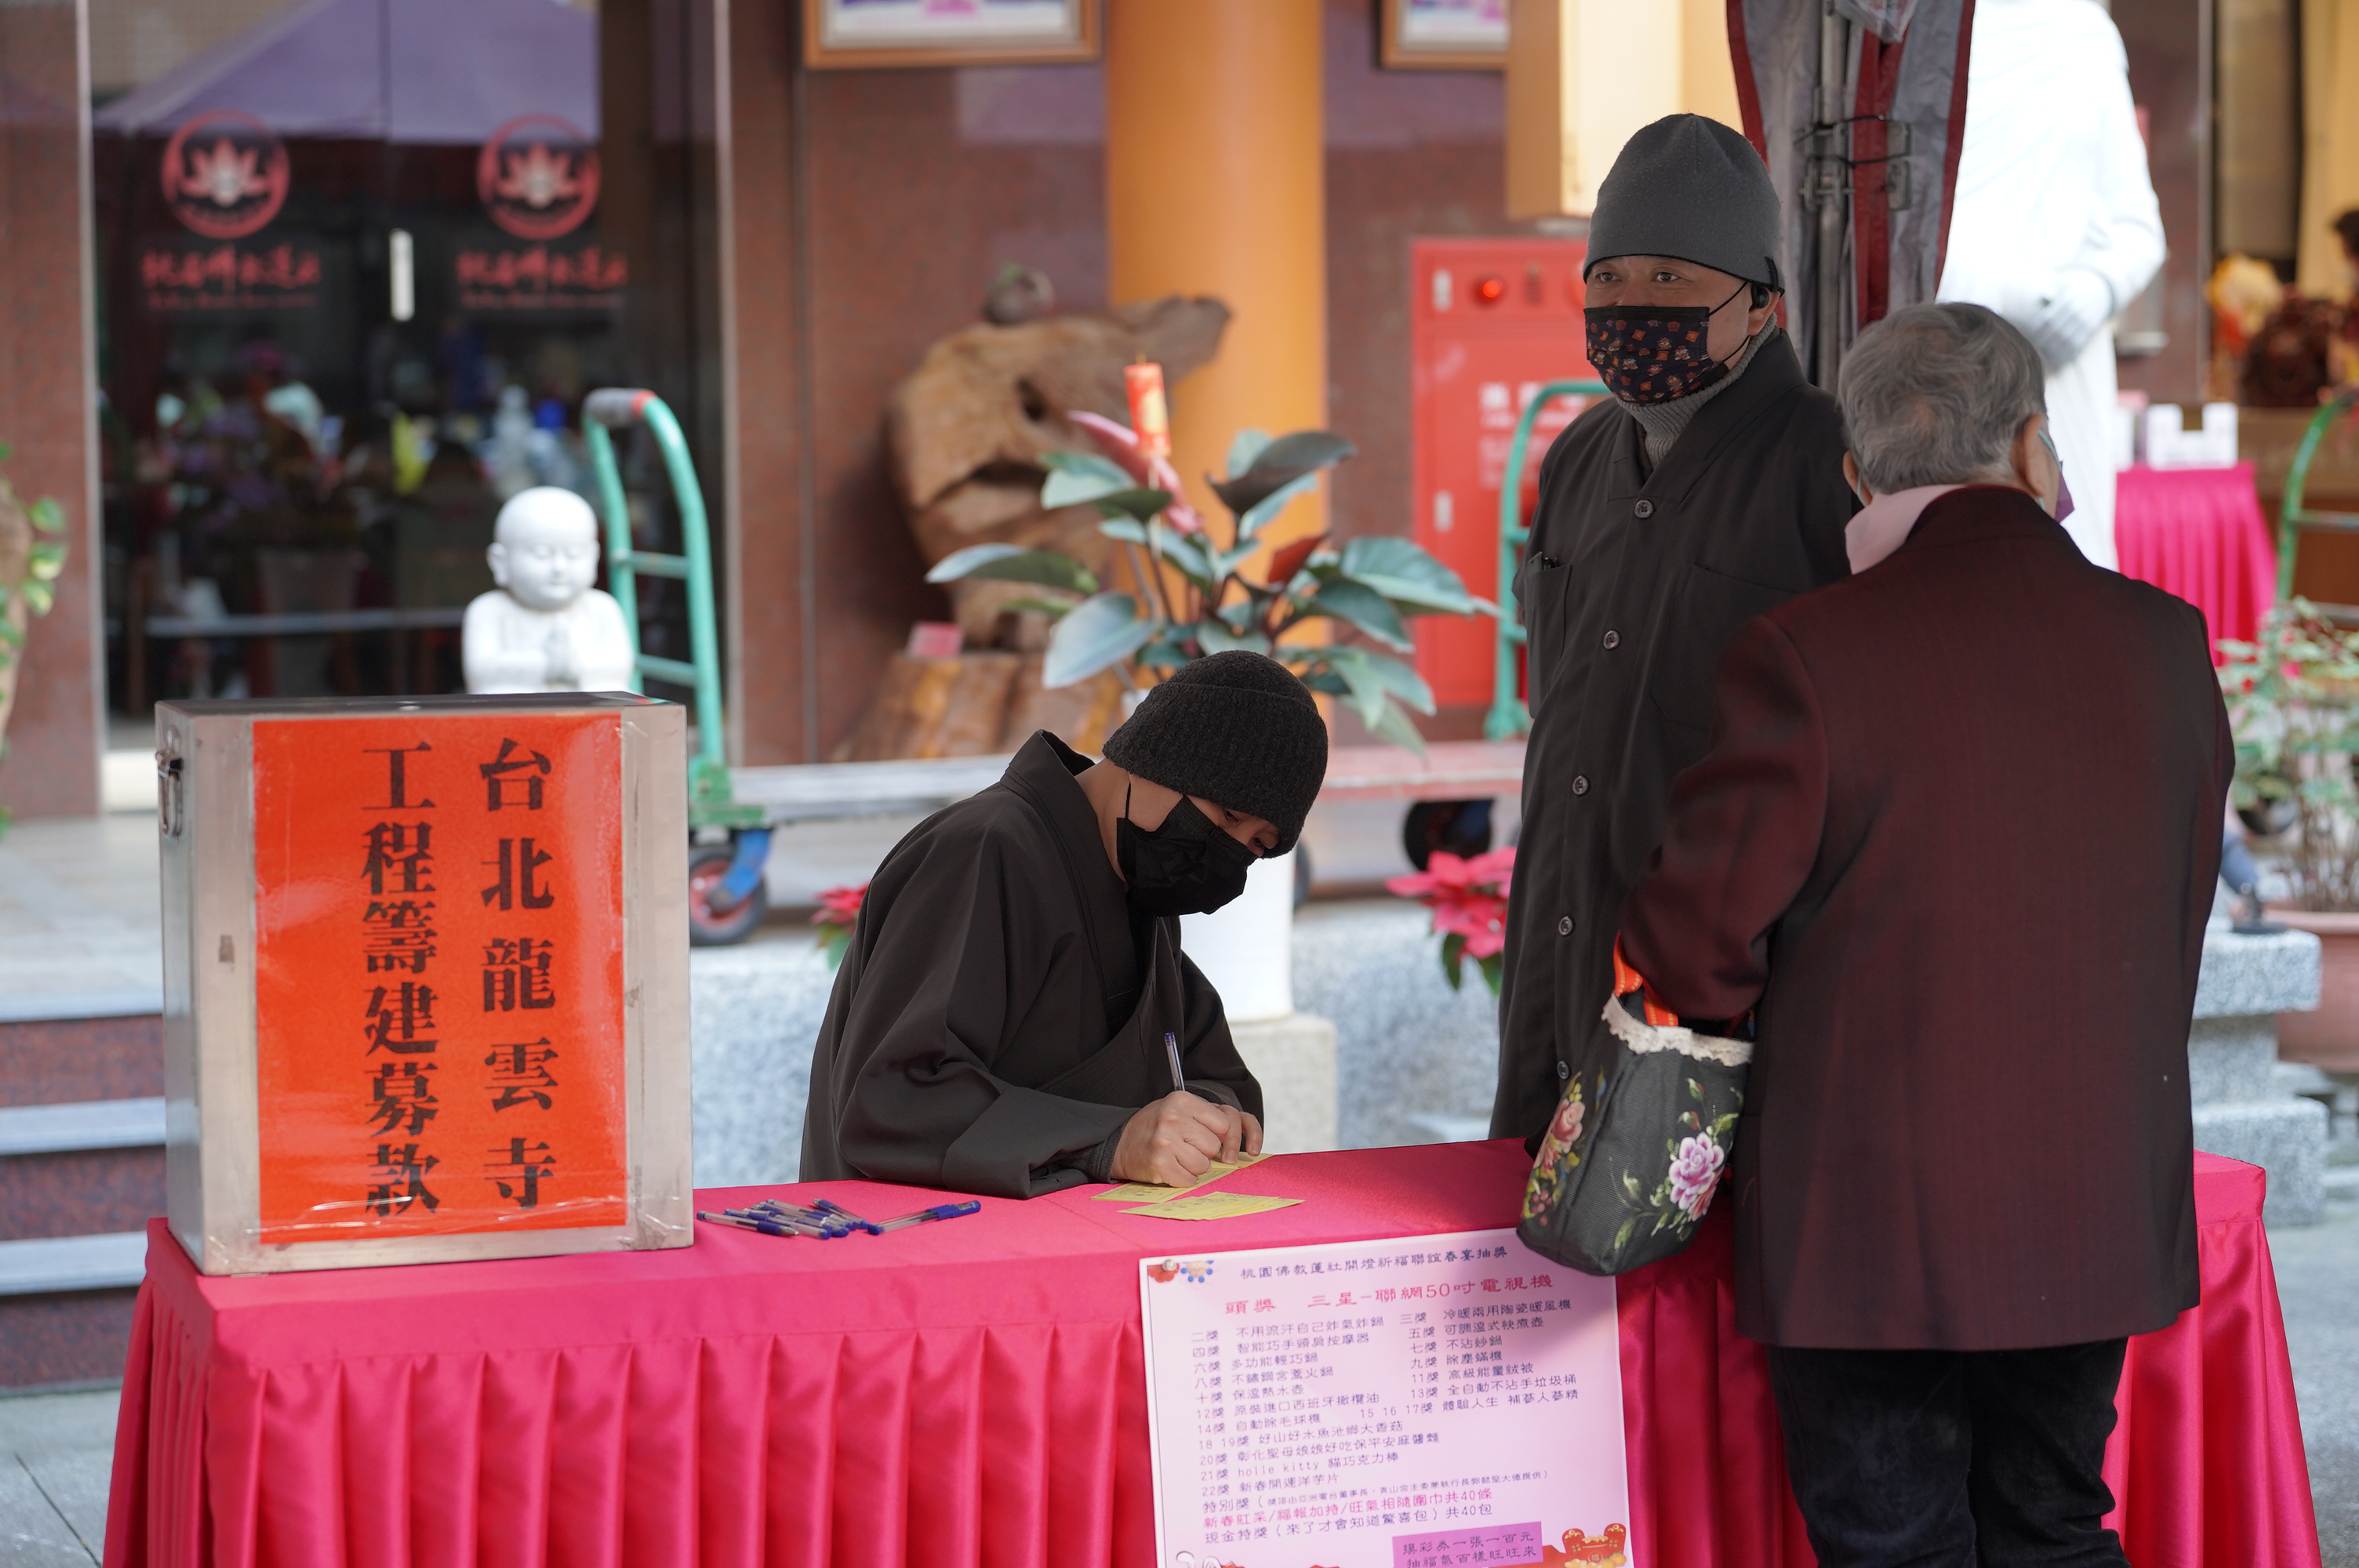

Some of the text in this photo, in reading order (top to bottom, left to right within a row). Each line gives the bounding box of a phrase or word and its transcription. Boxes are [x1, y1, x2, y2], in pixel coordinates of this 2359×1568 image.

[360, 742, 441, 1217] 工程籌建募款
[479, 738, 558, 1210] 台北龍雲寺
[1225, 1298, 1276, 1314] 頭獎
[1400, 1312, 1427, 1325] 三獎
[1191, 1330, 1219, 1342] 二獎
[1408, 1326, 1435, 1339] 五獎
[1192, 1345, 1219, 1357] 四獎
[1410, 1341, 1436, 1354] 七獎
[1194, 1352, 1318, 1374] 六獎 多功能輕巧鍋
[1410, 1356, 1437, 1370] 九獎
[1194, 1376, 1222, 1388] 八獎
[1412, 1371, 1439, 1383] 11獎
[1411, 1374, 1576, 1399] 13獎 全自動不沾手垃圾桶
[1196, 1392, 1223, 1403] 十獎
[1196, 1392, 1379, 1419] 12獎 原裝進口西班牙橄欖油
[1359, 1408, 1374, 1418] 15
[1383, 1406, 1397, 1417] 16
[1405, 1402, 1433, 1414] 17獎
[1441, 1396, 1498, 1411] 體驗人生
[1198, 1414, 1320, 1434] 14獎 自動除毛球機
[1198, 1439, 1212, 1450] 18
[1221, 1435, 1249, 1447] 19獎
[1199, 1453, 1227, 1466] 20獎
[1201, 1468, 1228, 1482] 21獎
[1282, 1461, 1319, 1472] kitty
[1327, 1451, 1399, 1468] 貓巧克力棒
[1201, 1473, 1338, 1497] 22獎 新春開運洋芋片
